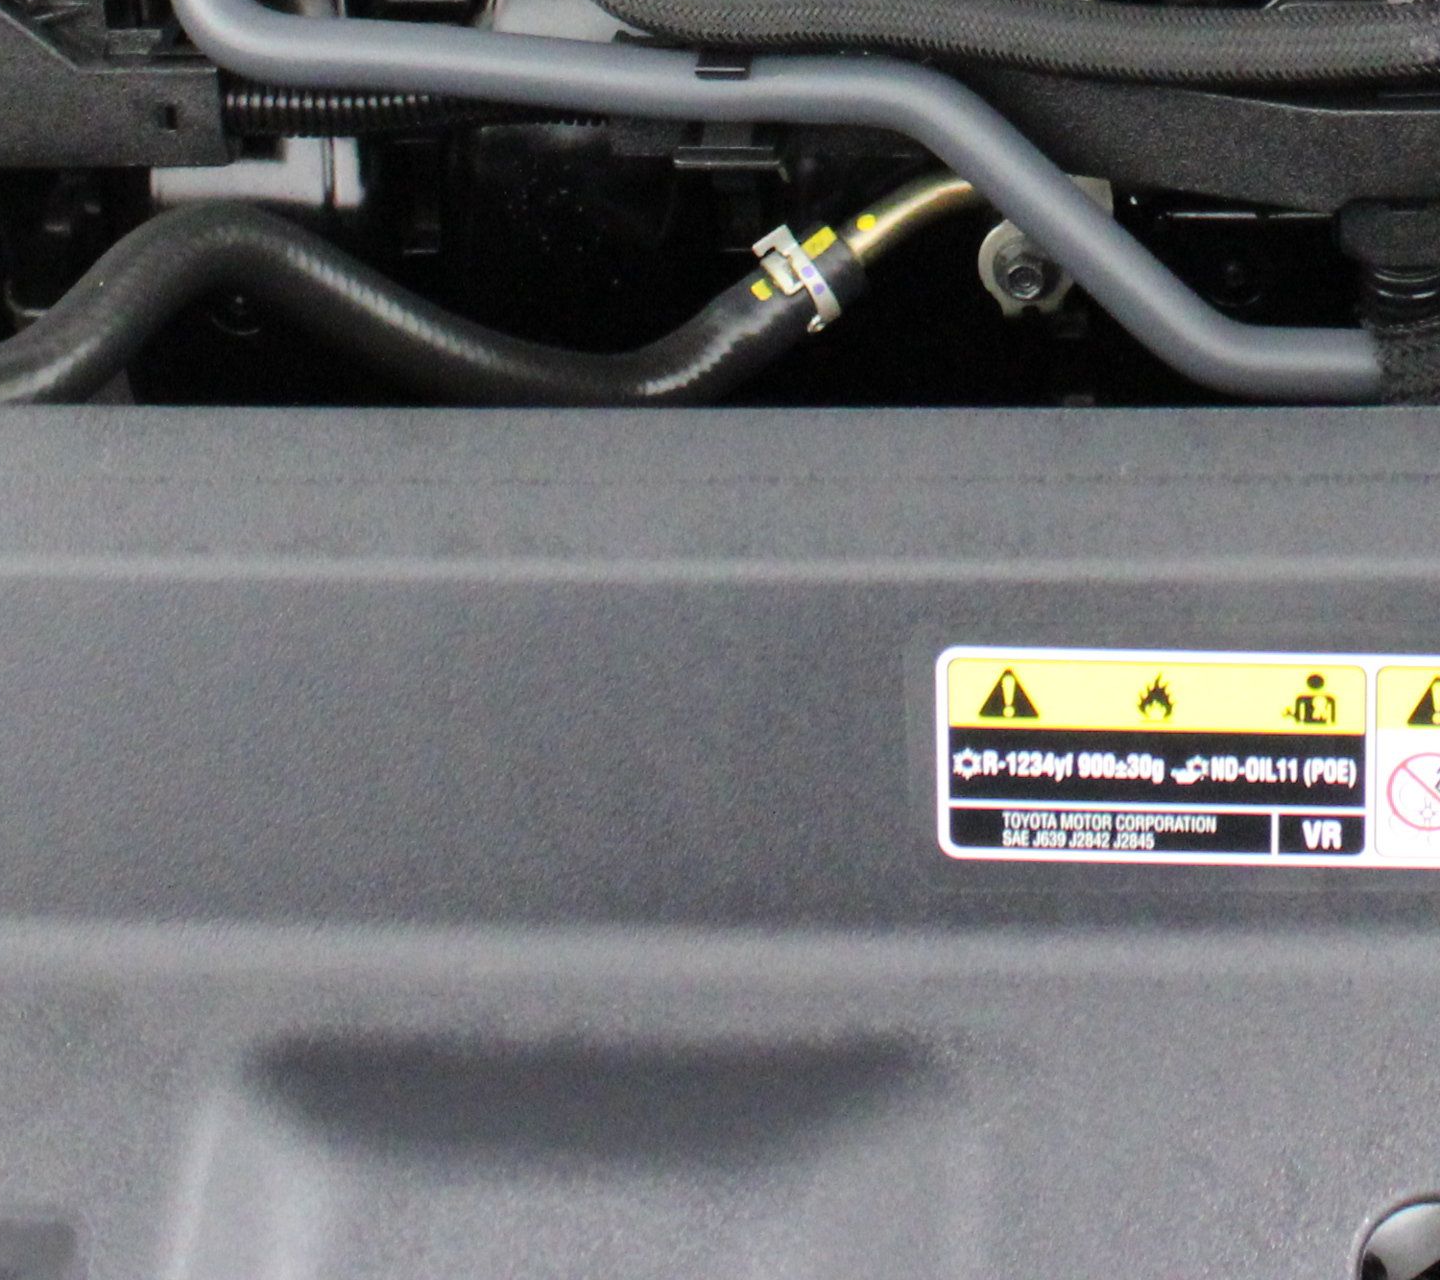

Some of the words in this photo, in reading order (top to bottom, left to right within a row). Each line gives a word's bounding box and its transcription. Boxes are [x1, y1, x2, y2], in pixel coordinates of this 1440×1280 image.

[982, 749, 1075, 783] R-1234yf
[1077, 750, 1165, 785] 900±30g
[1210, 755, 1299, 783] ND-OIL11
[1303, 756, 1357, 789] (POE)
[1001, 811, 1058, 830] TOYOTA
[1060, 813, 1111, 831] MOTOR
[1115, 814, 1218, 834] CORPORATION
[1301, 819, 1342, 850] VR
[1001, 829, 1030, 848] SAE
[1032, 830, 1066, 848] J639
[1069, 831, 1110, 849] J2842
[1113, 832, 1155, 850] J2845
